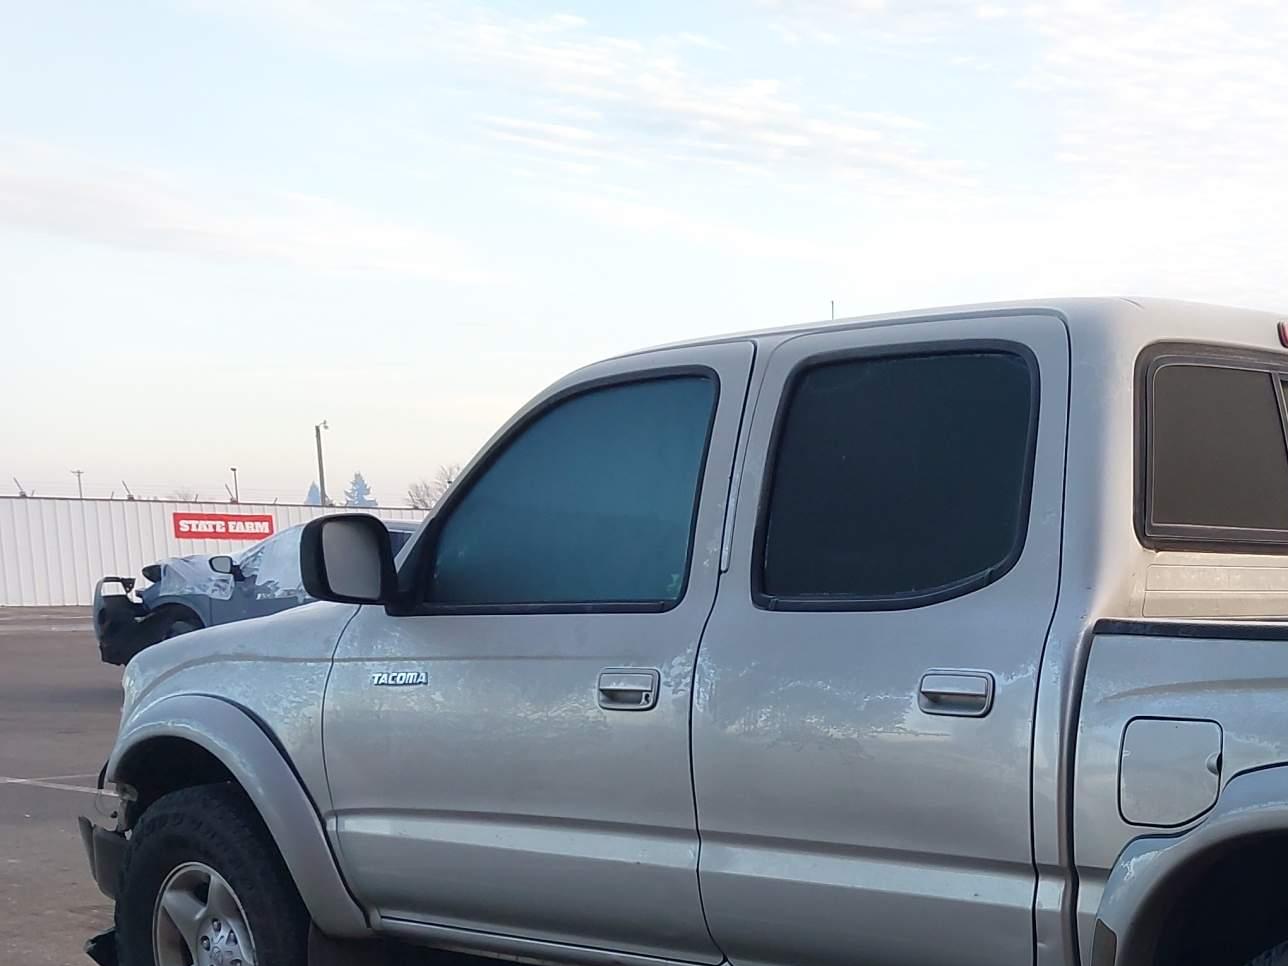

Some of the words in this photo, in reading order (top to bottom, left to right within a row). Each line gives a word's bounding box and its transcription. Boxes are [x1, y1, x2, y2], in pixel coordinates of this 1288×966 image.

[179, 519, 226, 533] STATE
[227, 521, 270, 534] FARM
[371, 671, 428, 686] TACOMA
